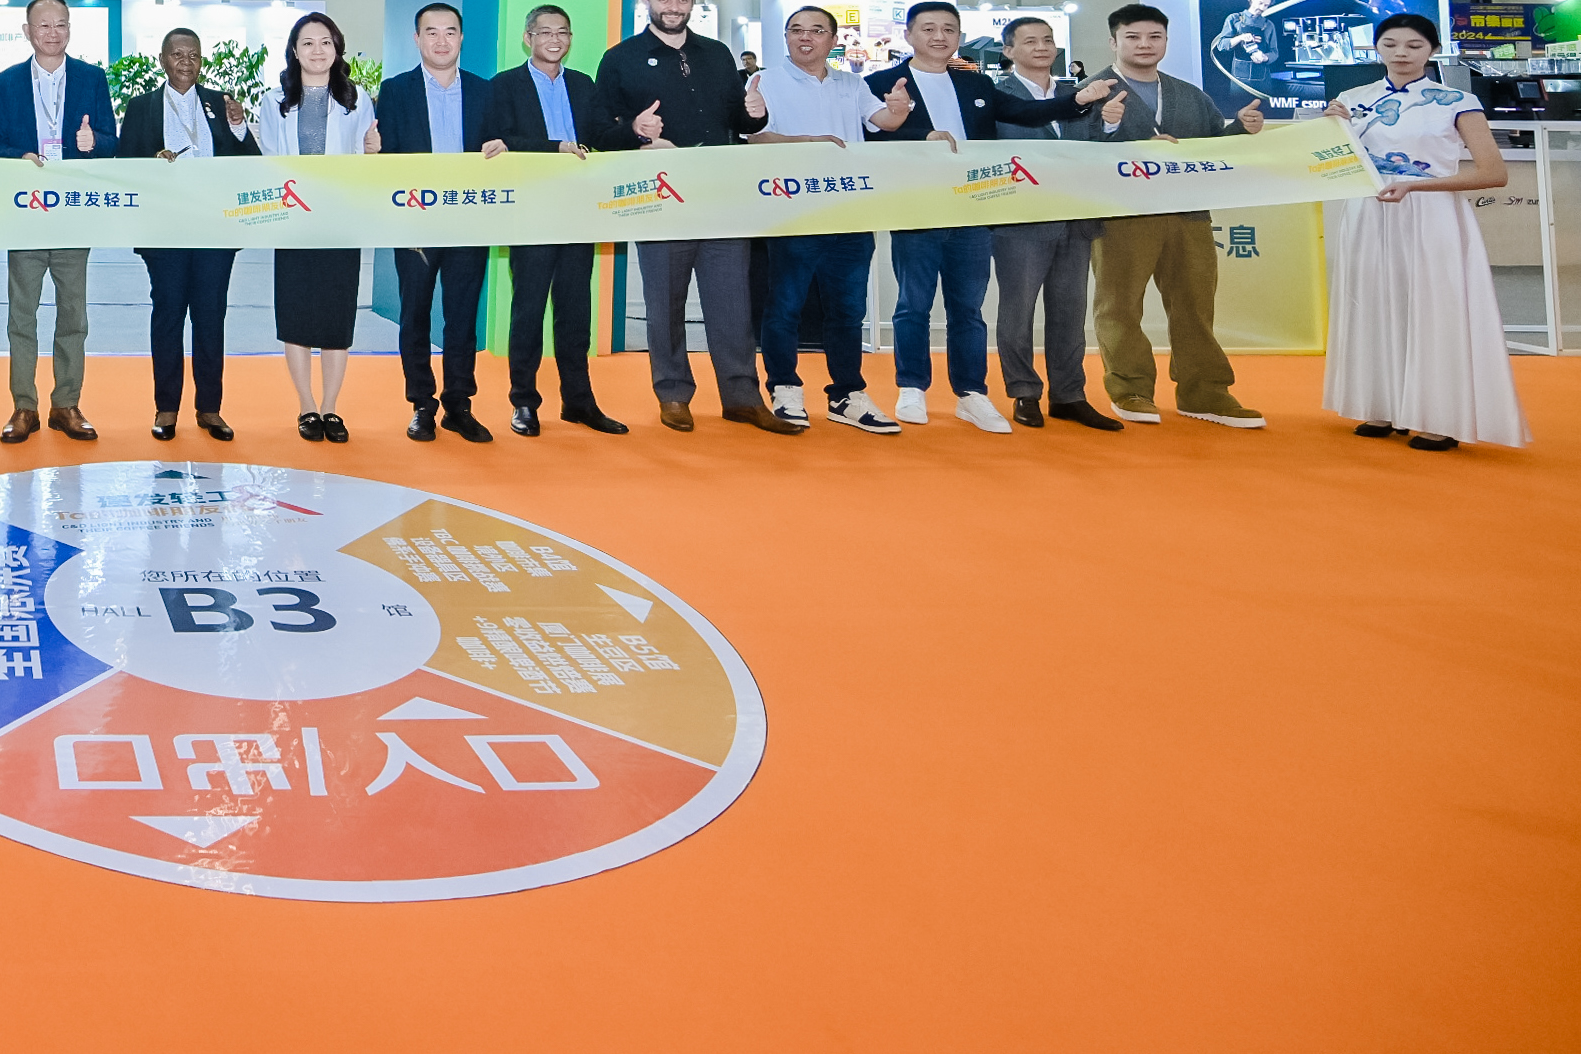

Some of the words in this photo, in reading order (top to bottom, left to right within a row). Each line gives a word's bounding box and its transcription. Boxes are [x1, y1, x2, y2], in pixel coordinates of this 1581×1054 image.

[1269, 97, 1299, 108] WMF
[967, 162, 1014, 182] 建发轻工
[1117, 160, 1161, 180] C&D
[237, 186, 284, 205] 建发轻工
[613, 178, 658, 198] 建发轻工
[758, 177, 800, 199] C&D
[804, 175, 874, 193] 建发轻工
[13, 189, 60, 212] C&D
[64, 191, 140, 208] 建发轻工
[391, 188, 438, 210] C&D
[442, 188, 516, 206] 建发轻工
[98, 490, 235, 508] 建发轻工
[430, 528, 459, 545] TBC
[529, 545, 578, 571] B4馆
[140, 569, 326, 583] 您所在的位置
[81, 605, 152, 618] HALL
[158, 587, 337, 633] B3
[381, 603, 413, 618] 馆
[536, 621, 625, 686] 厦门咖啡展
[581, 633, 645, 673] 生豆区
[618, 634, 681, 671] B5馆
[54, 733, 289, 796] 出口
[364, 731, 601, 797] 入口
